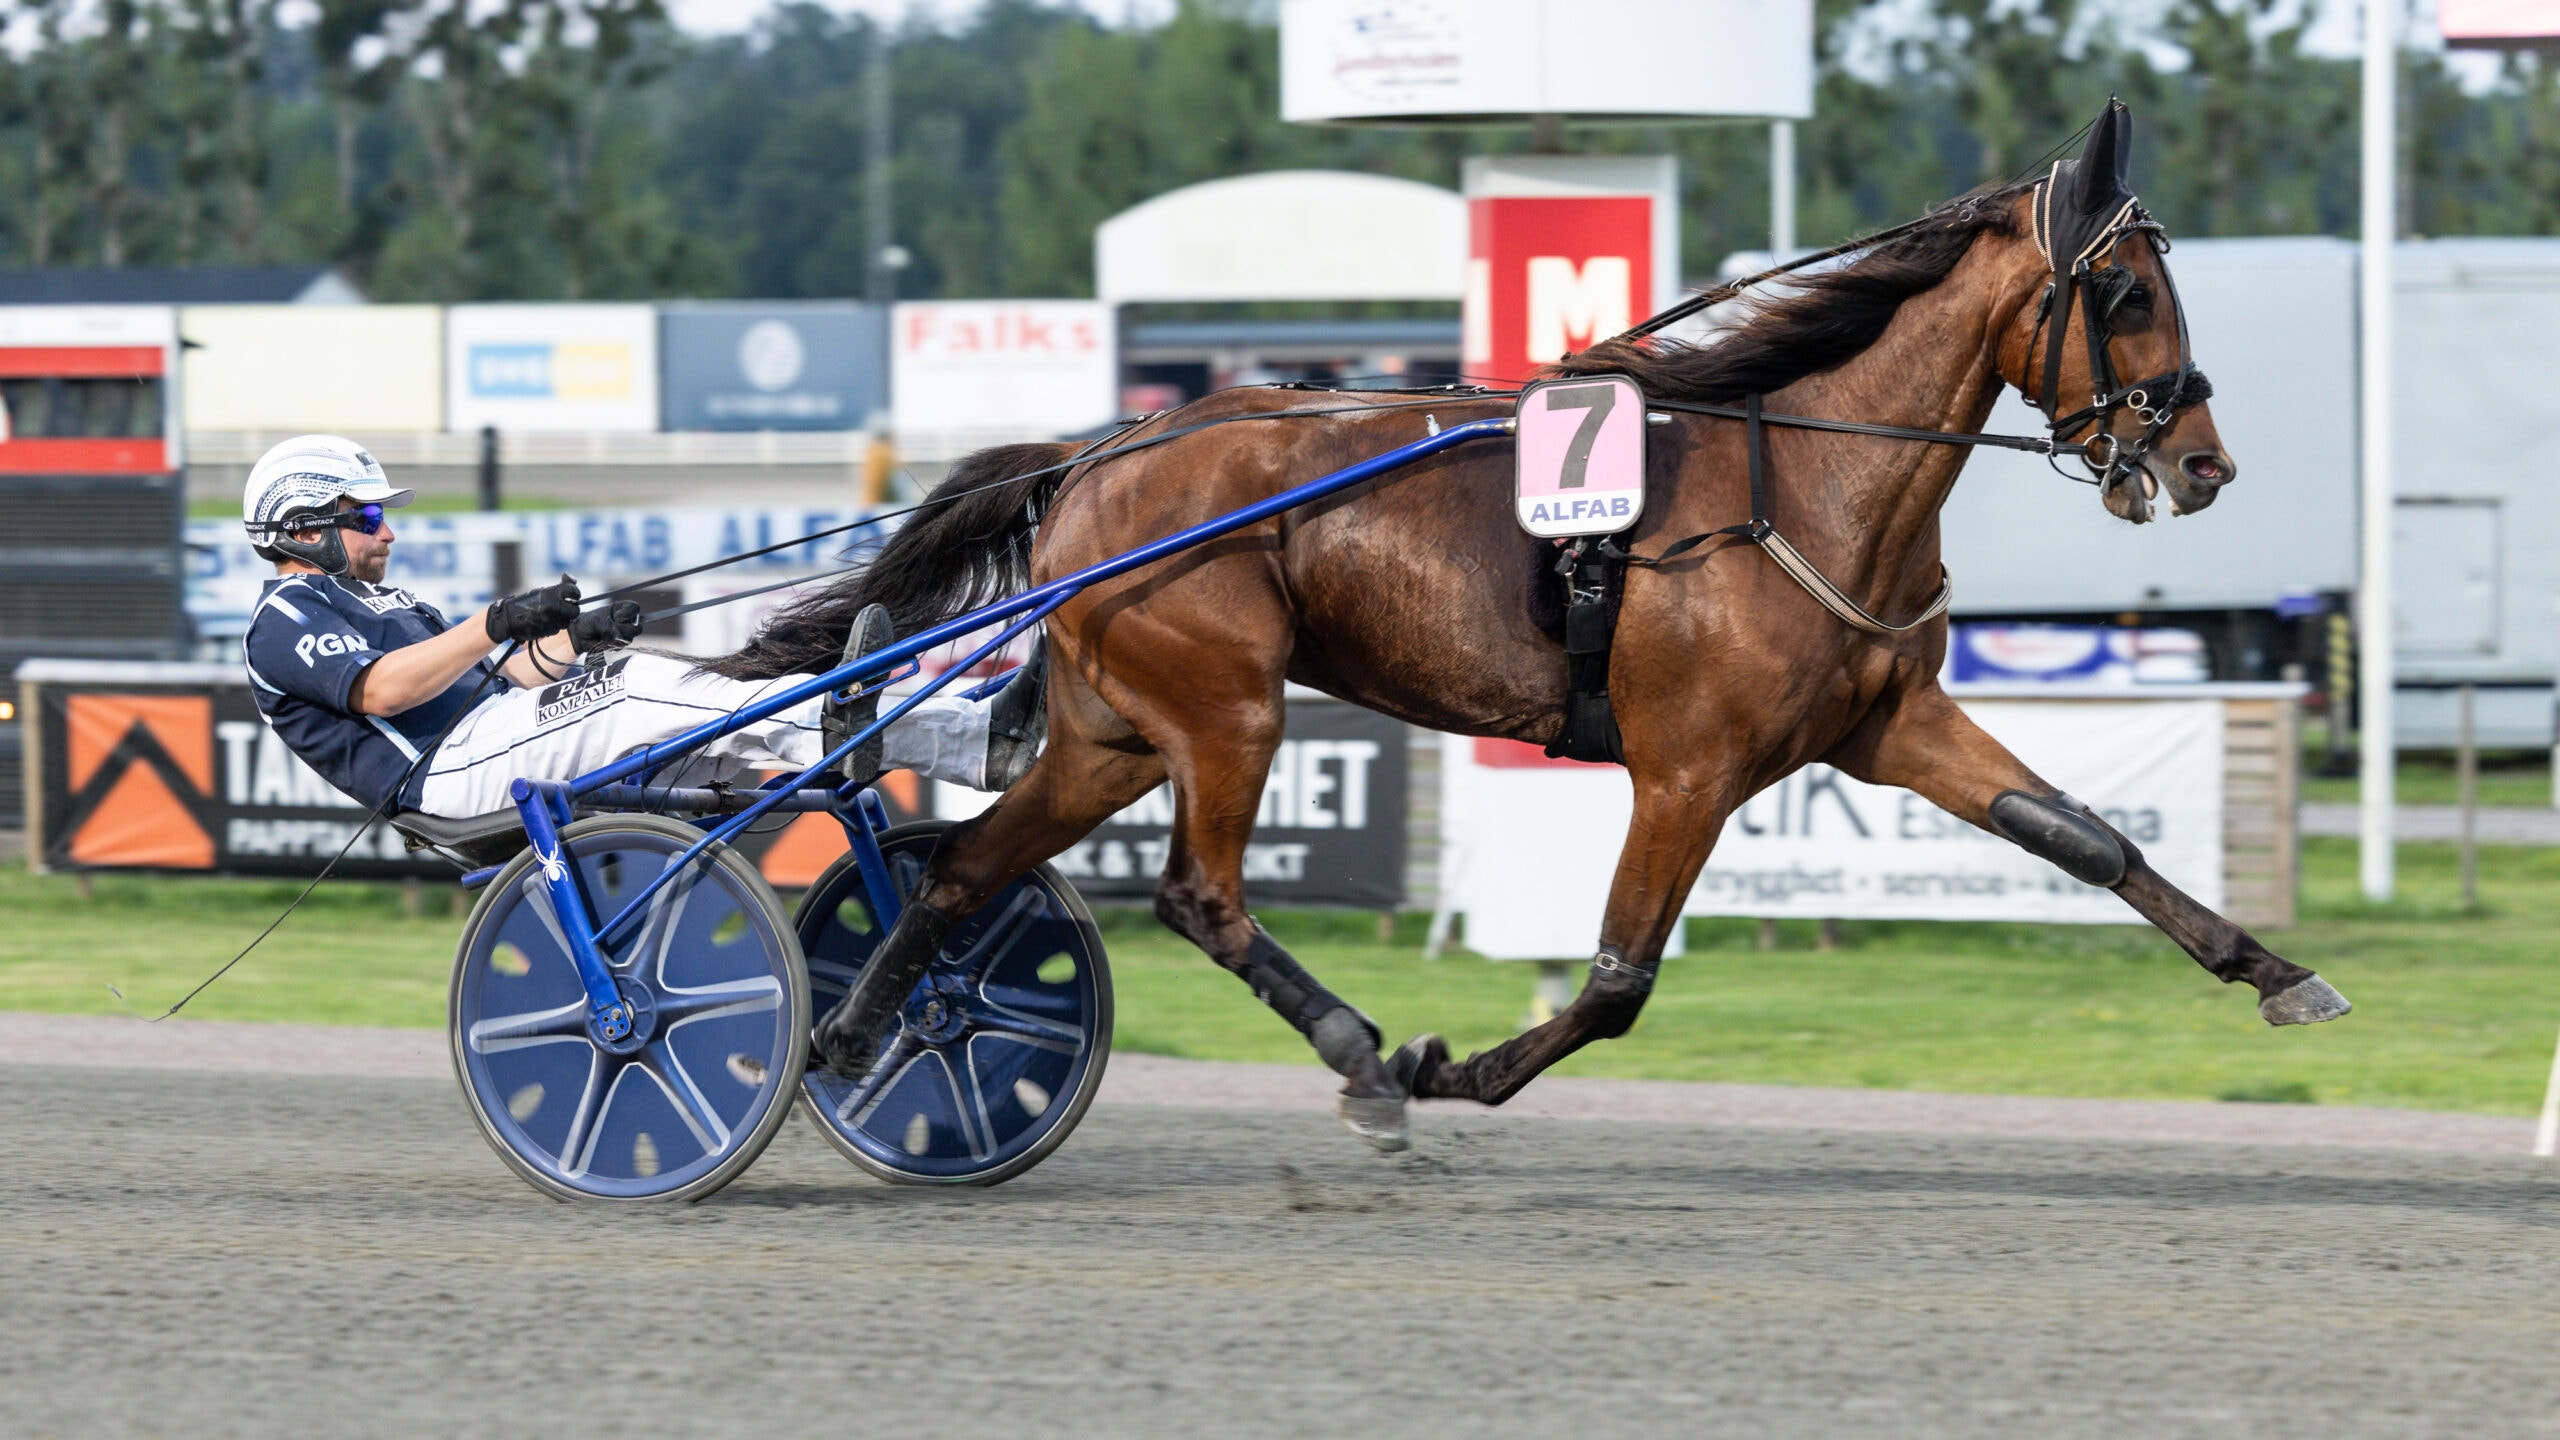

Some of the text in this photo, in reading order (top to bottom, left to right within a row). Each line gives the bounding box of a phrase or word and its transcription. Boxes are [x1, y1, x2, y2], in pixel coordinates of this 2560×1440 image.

[1546, 384, 1616, 489] 7
[1530, 498, 1630, 522] ALFAB
[548, 511, 672, 570] LFAB
